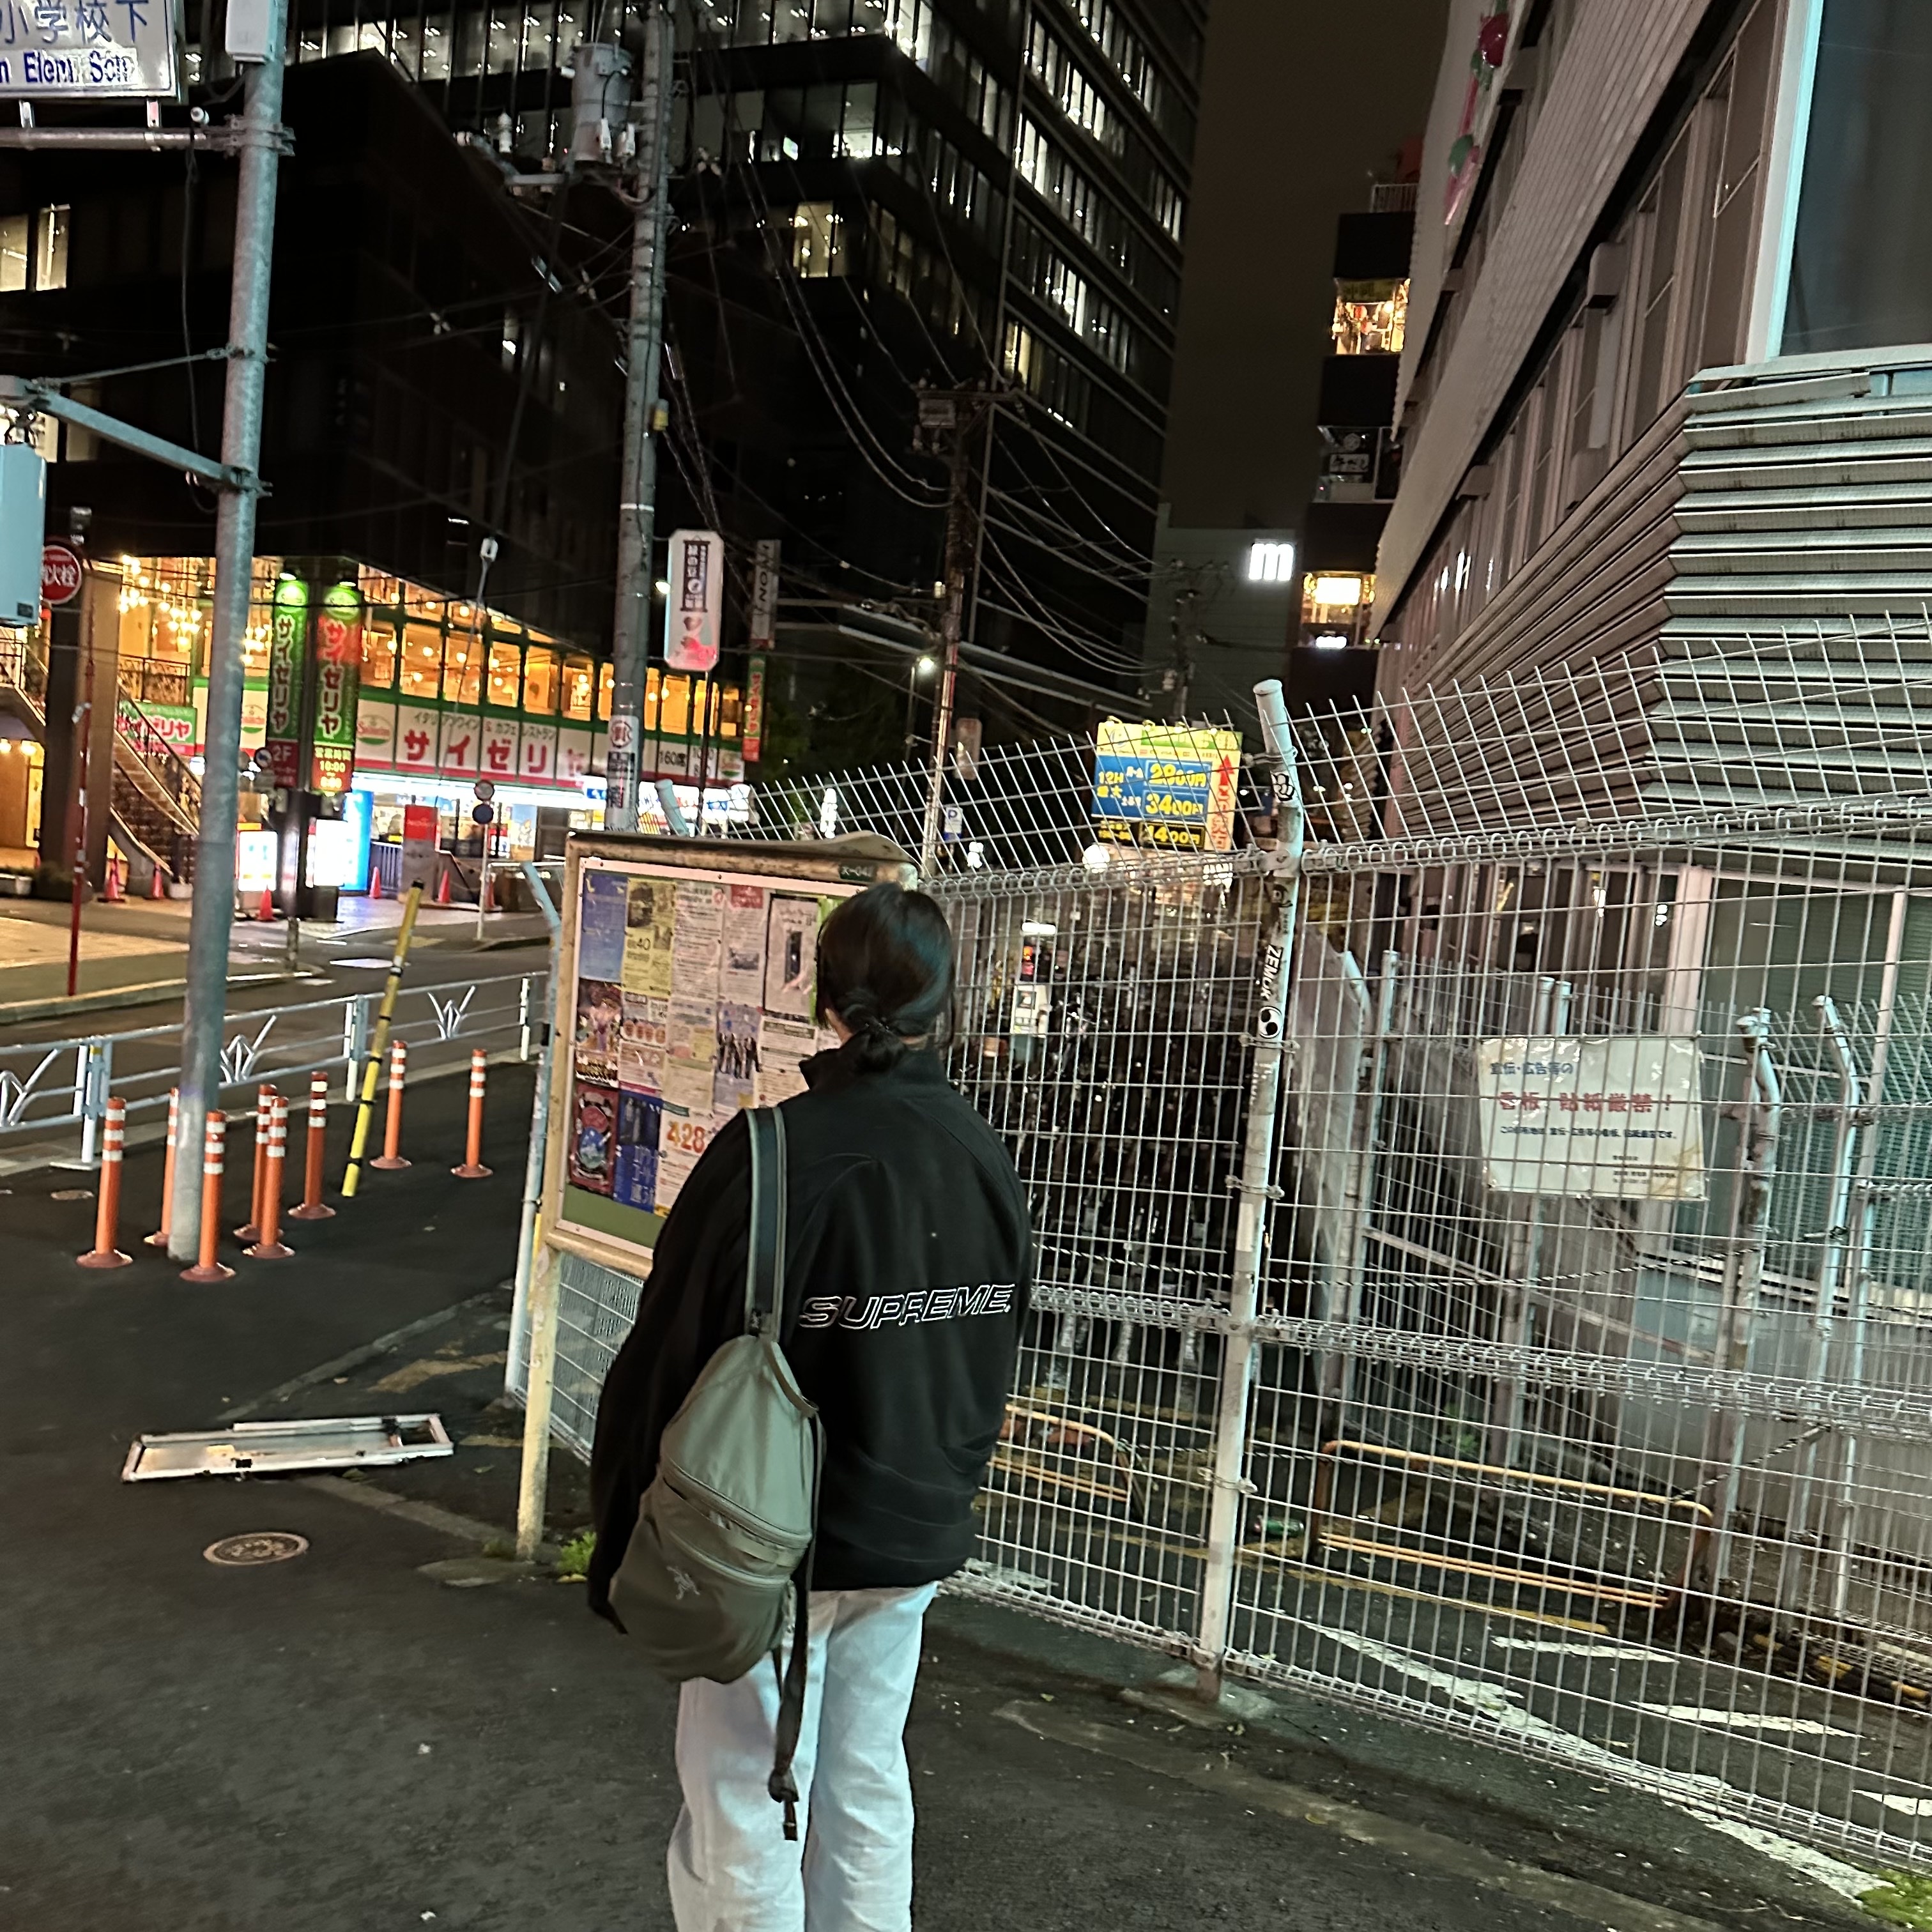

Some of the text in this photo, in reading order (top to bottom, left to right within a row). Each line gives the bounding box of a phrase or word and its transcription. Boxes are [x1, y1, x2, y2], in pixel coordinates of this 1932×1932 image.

[0, 0, 149, 43] 小学校下
[319, 620, 346, 737] サイゼリヤ
[272, 745, 292, 762] 2F
[319, 760, 346, 773] 10:00
[404, 729, 586, 778] サイゼリヤ
[1099, 771, 1124, 785] 12H
